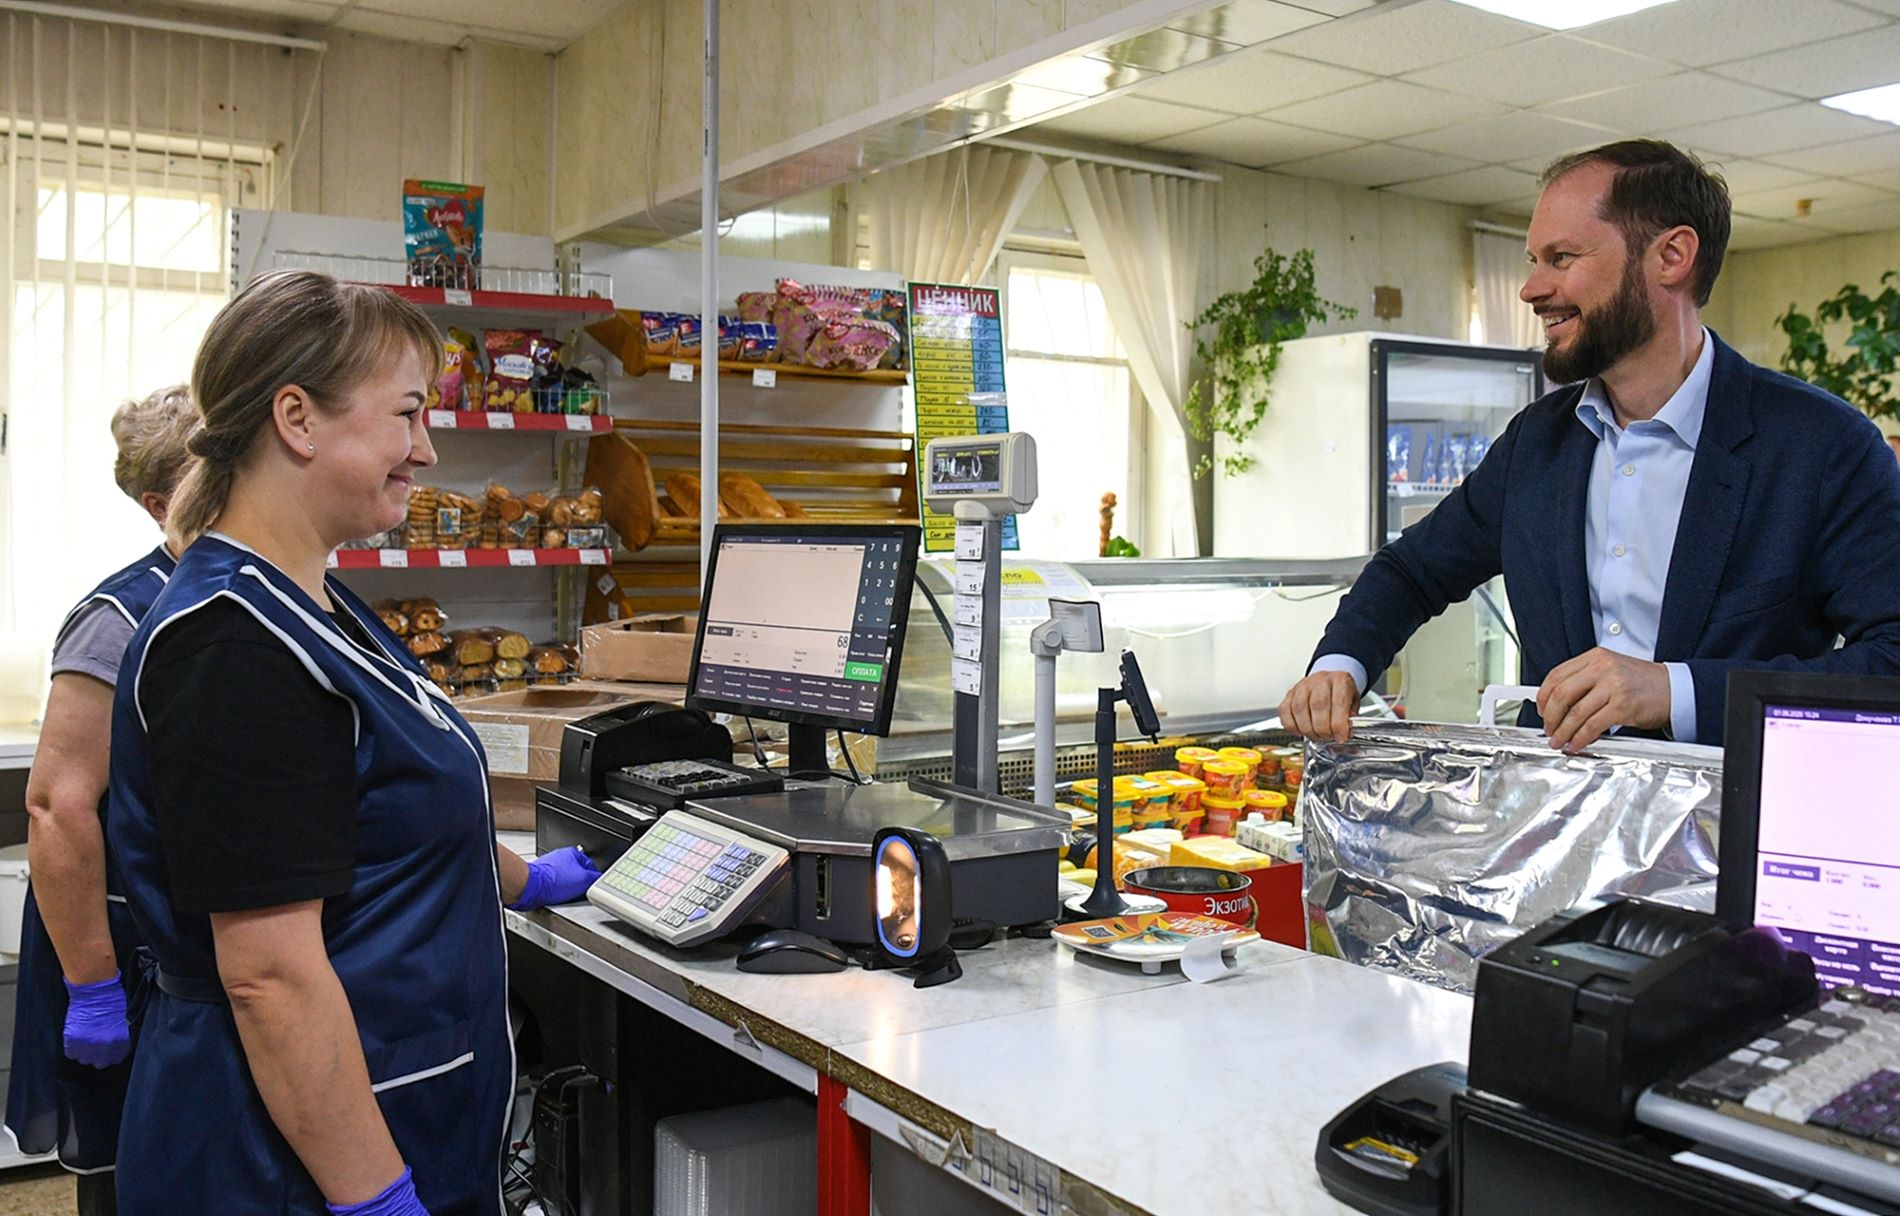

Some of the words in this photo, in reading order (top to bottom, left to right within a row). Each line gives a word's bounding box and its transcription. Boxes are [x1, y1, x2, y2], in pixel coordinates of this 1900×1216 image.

[917, 289, 994, 313] ЦЕННИК
[870, 543, 875, 551] 7
[882, 543, 888, 552] 8
[895, 543, 901, 552] 9
[866, 560, 872, 569] 4
[879, 560, 885, 570] 5
[892, 561, 898, 570] 6
[876, 578, 882, 588] 2
[889, 579, 895, 588] 3
[861, 595, 866, 604] 0
[884, 597, 894, 606] 00
[837, 634, 848, 648] 68
[852, 666, 878, 677] ОПЛАТА
